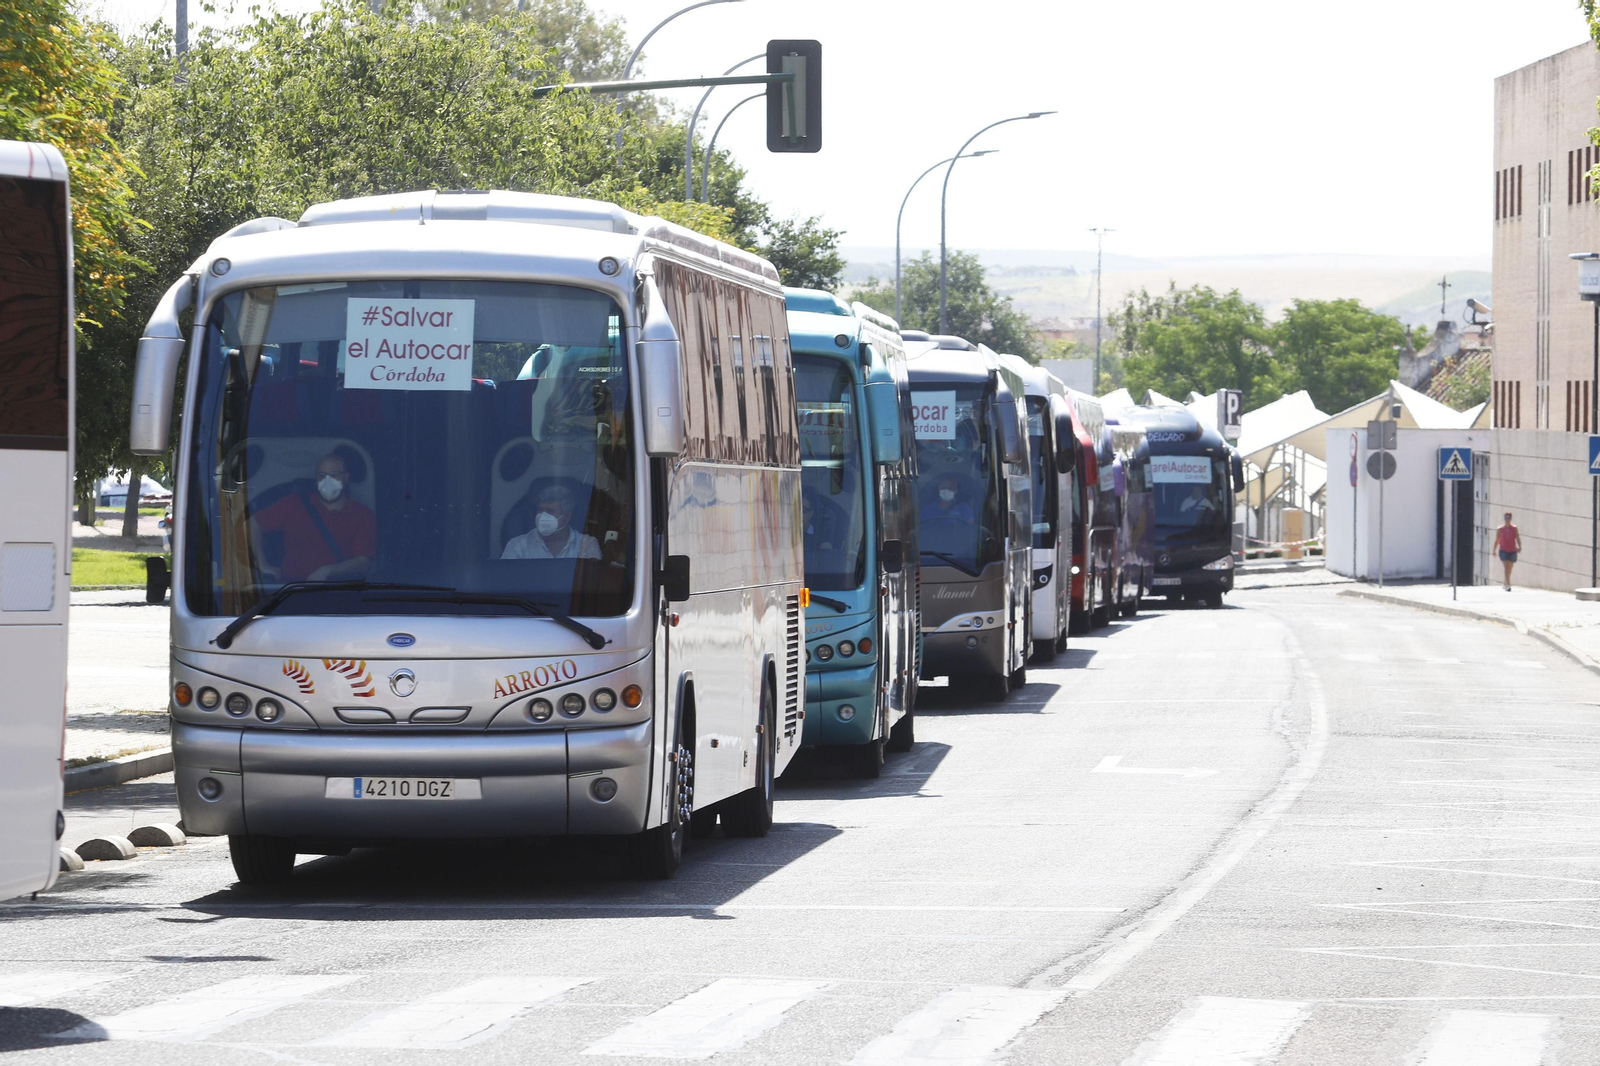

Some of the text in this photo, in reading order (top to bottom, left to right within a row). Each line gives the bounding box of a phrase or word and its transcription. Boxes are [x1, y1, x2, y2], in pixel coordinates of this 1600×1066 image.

[362, 306, 453, 327] #Salvar
[348, 338, 471, 360] el Autocar
[370, 365, 446, 382] Córdoba
[1227, 393, 1239, 425] P
[932, 585, 978, 599] Manuel
[493, 659, 578, 699] ARROYO
[365, 780, 410, 796] 4210
[417, 781, 451, 797] DGZ
